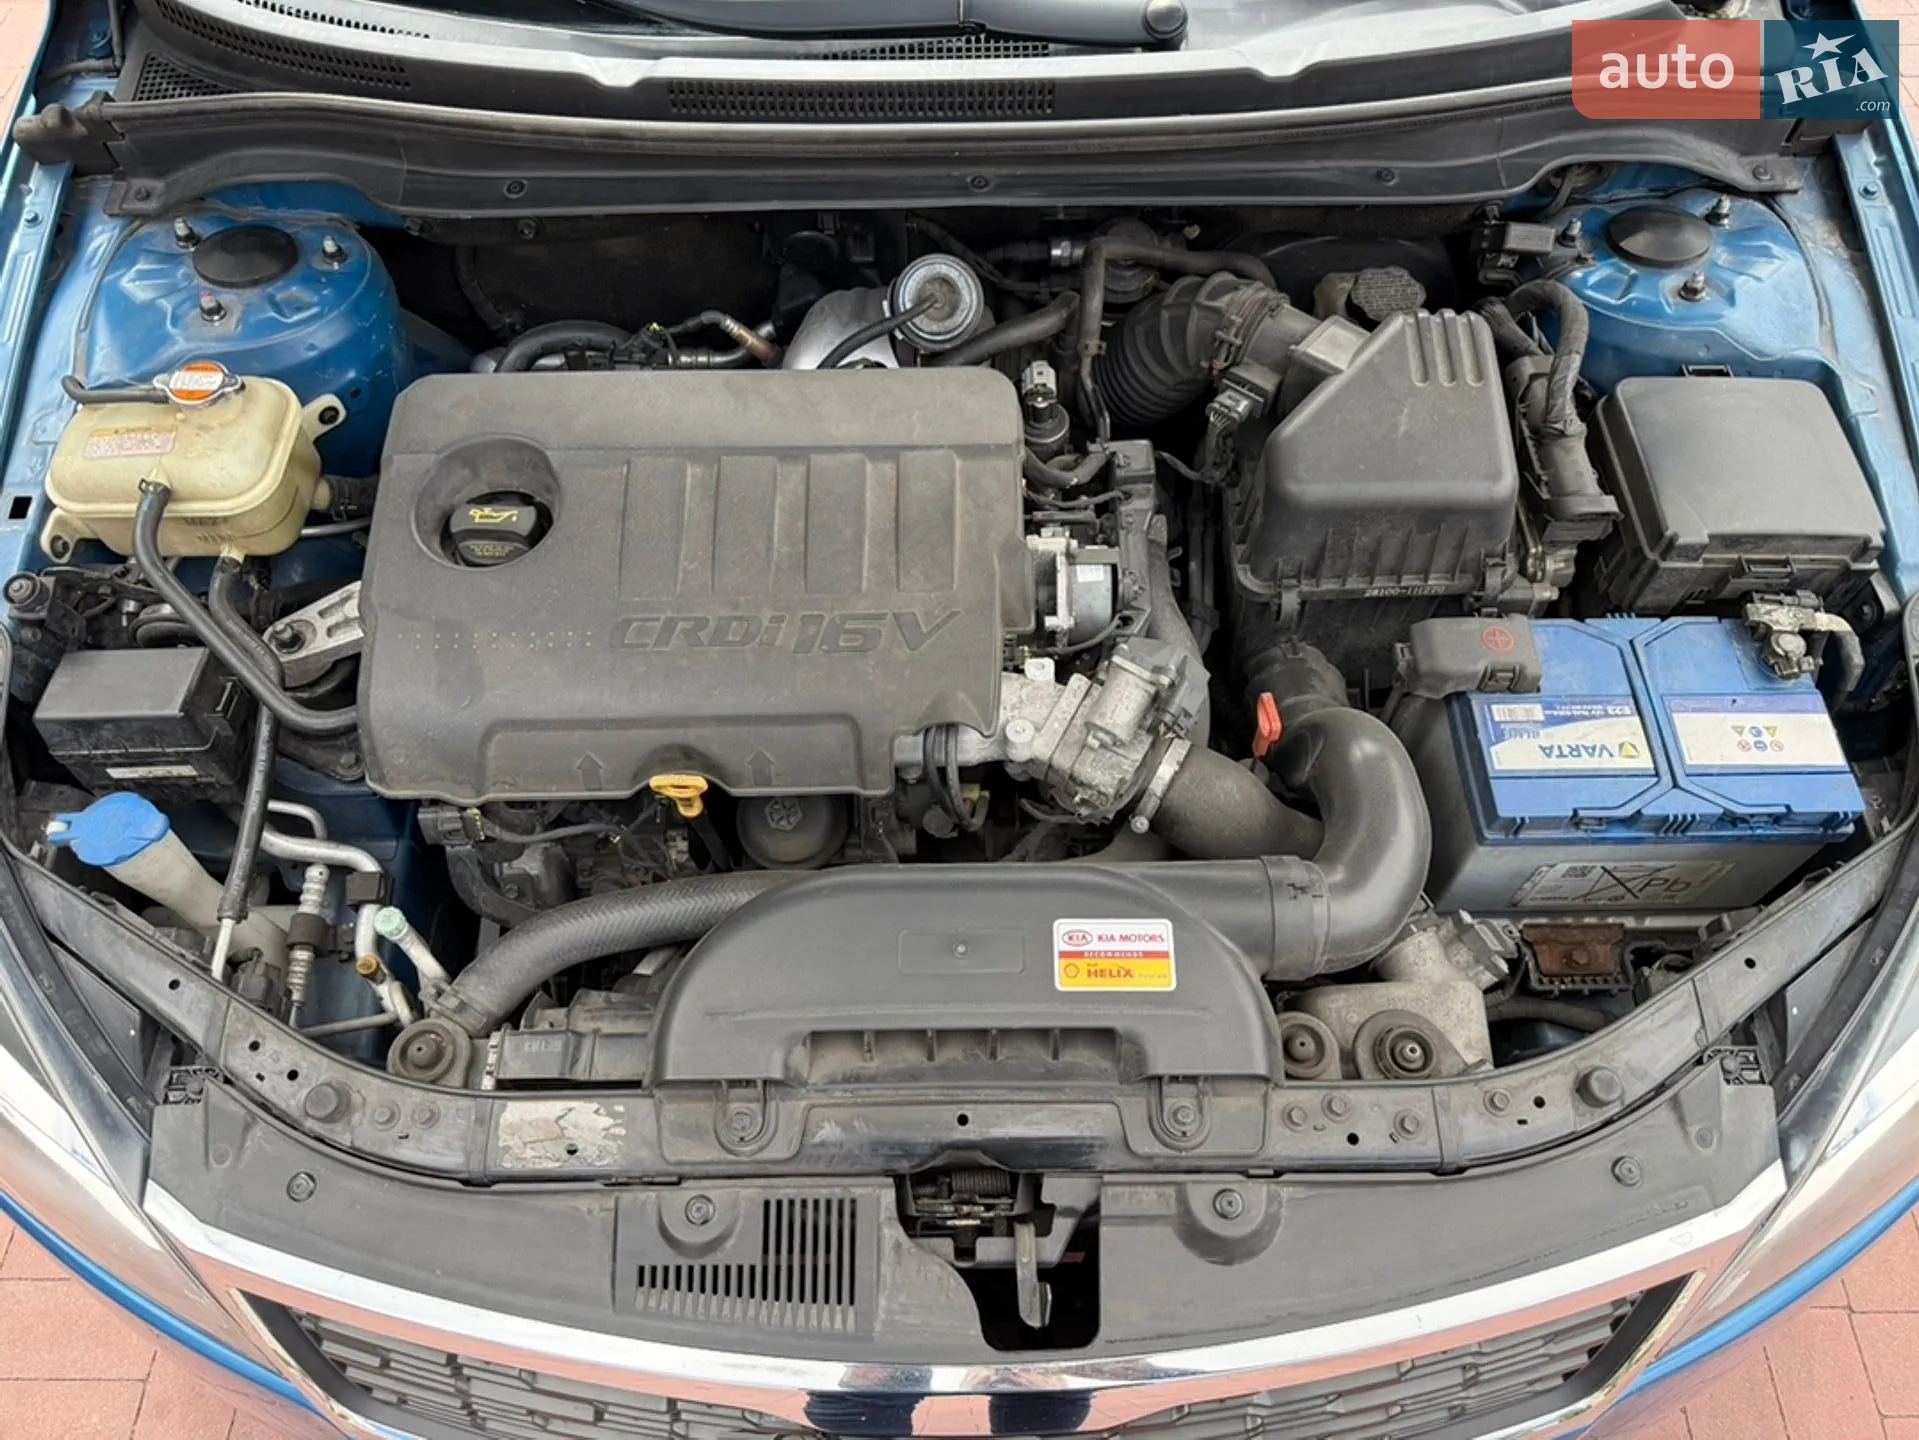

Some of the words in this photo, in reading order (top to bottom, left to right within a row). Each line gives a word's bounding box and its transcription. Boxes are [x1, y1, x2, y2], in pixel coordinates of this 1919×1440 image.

[1538, 744, 1615, 758] VARTA
[1637, 877, 1691, 893] Pb
[1097, 934, 1115, 942] KIA
[1119, 934, 1165, 944] MOTORS
[1087, 968, 1134, 979] HELIX
